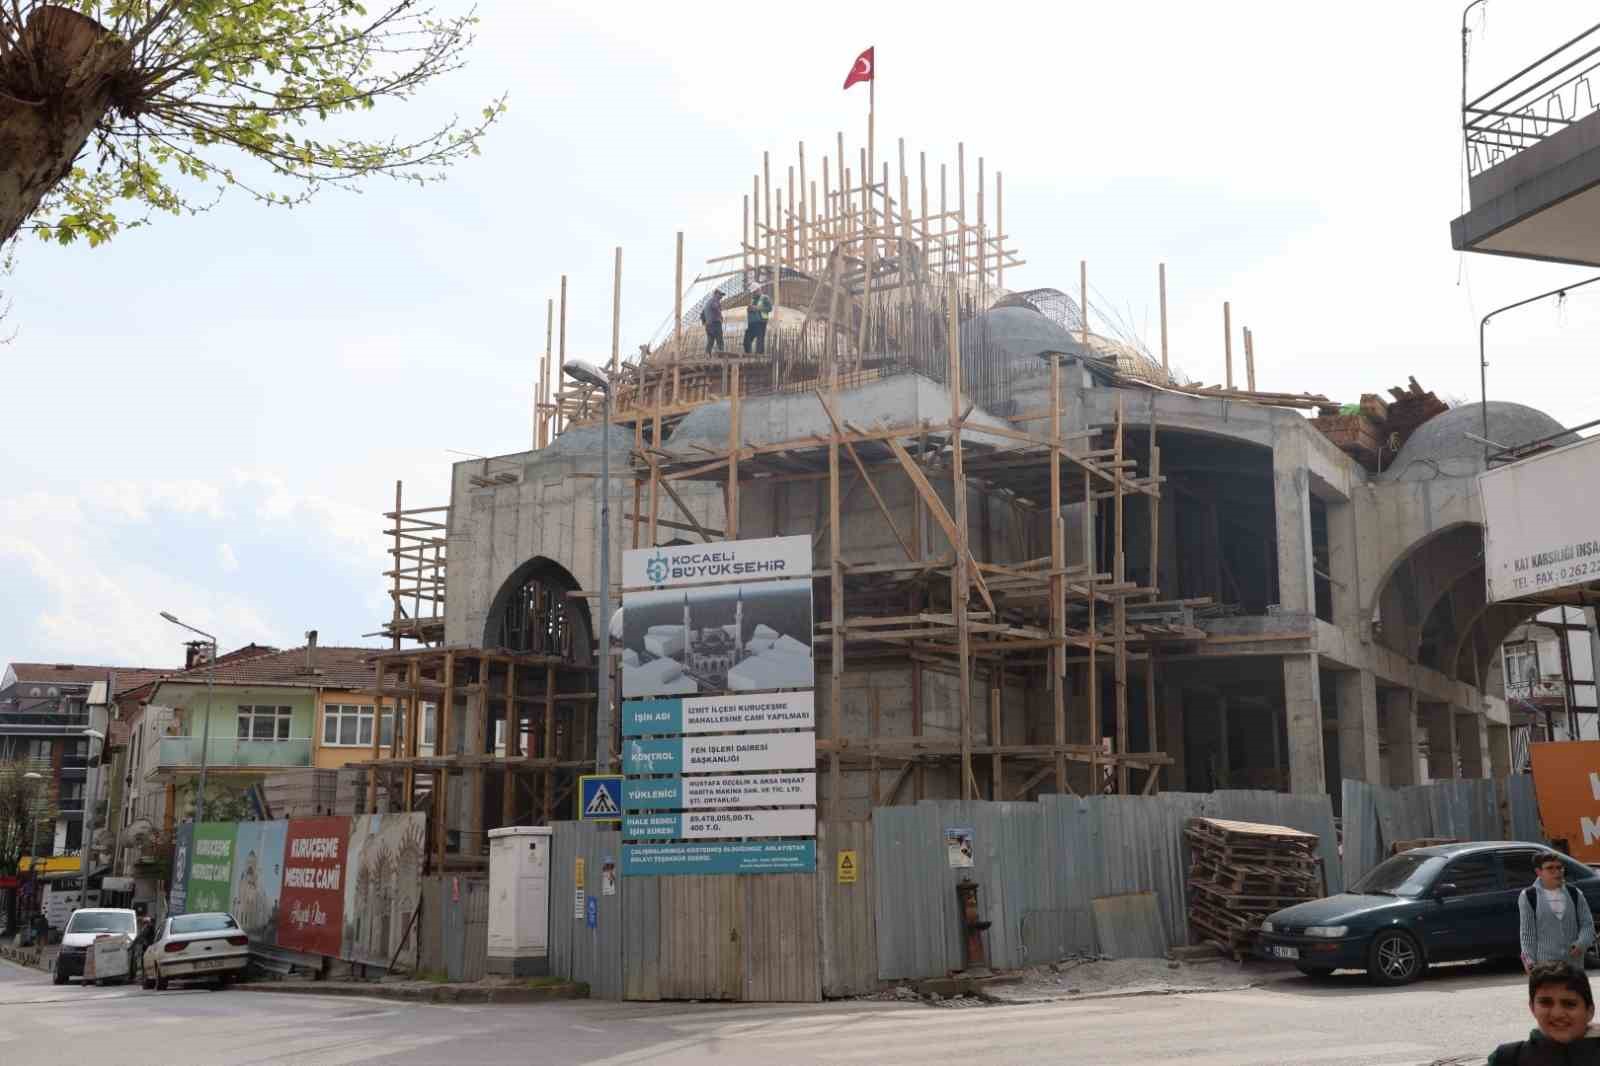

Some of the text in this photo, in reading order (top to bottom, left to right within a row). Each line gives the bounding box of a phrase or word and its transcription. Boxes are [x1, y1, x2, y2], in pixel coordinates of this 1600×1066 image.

[1536, 570, 1552, 585] FAX
[655, 712, 671, 722] ADI
[691, 746, 706, 754] FEN
[631, 752, 675, 762] KONTROL
[285, 868, 316, 889] MERKEZ
